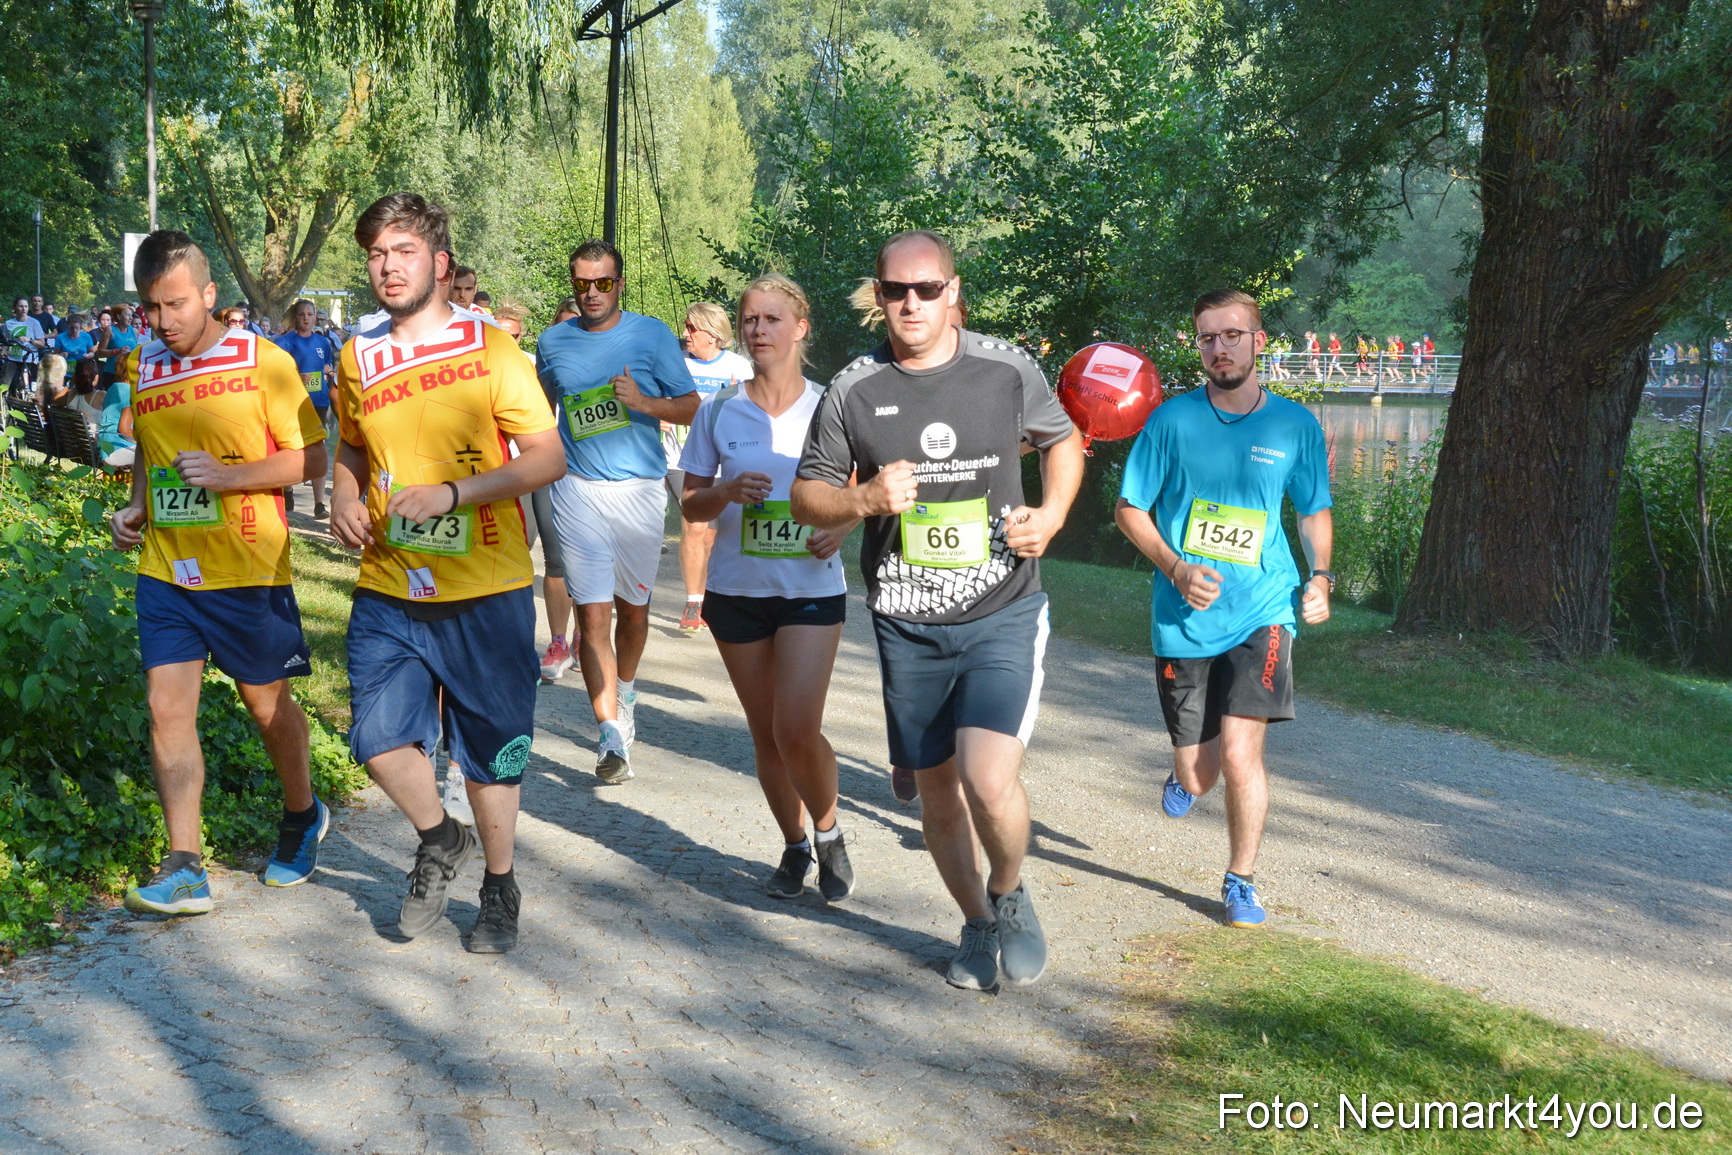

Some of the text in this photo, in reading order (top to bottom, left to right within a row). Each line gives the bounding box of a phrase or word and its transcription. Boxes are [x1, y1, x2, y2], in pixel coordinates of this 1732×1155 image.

[136, 376, 259, 417] MAX BÖGL
[363, 360, 491, 417] MAX BÖGL
[1067, 382, 1118, 406] DEHN schüt
[574, 400, 618, 426] 1809
[875, 406, 899, 416] JAKO
[1250, 455, 1275, 465] Thomas
[156, 488, 210, 510] 1274
[431, 537, 453, 545] Burak
[749, 519, 803, 541] 1147
[927, 526, 960, 549] 66
[1198, 521, 1254, 549] 1542
[1200, 541, 1244, 555] Mulzer Thomas
[1261, 624, 1281, 692] predator
